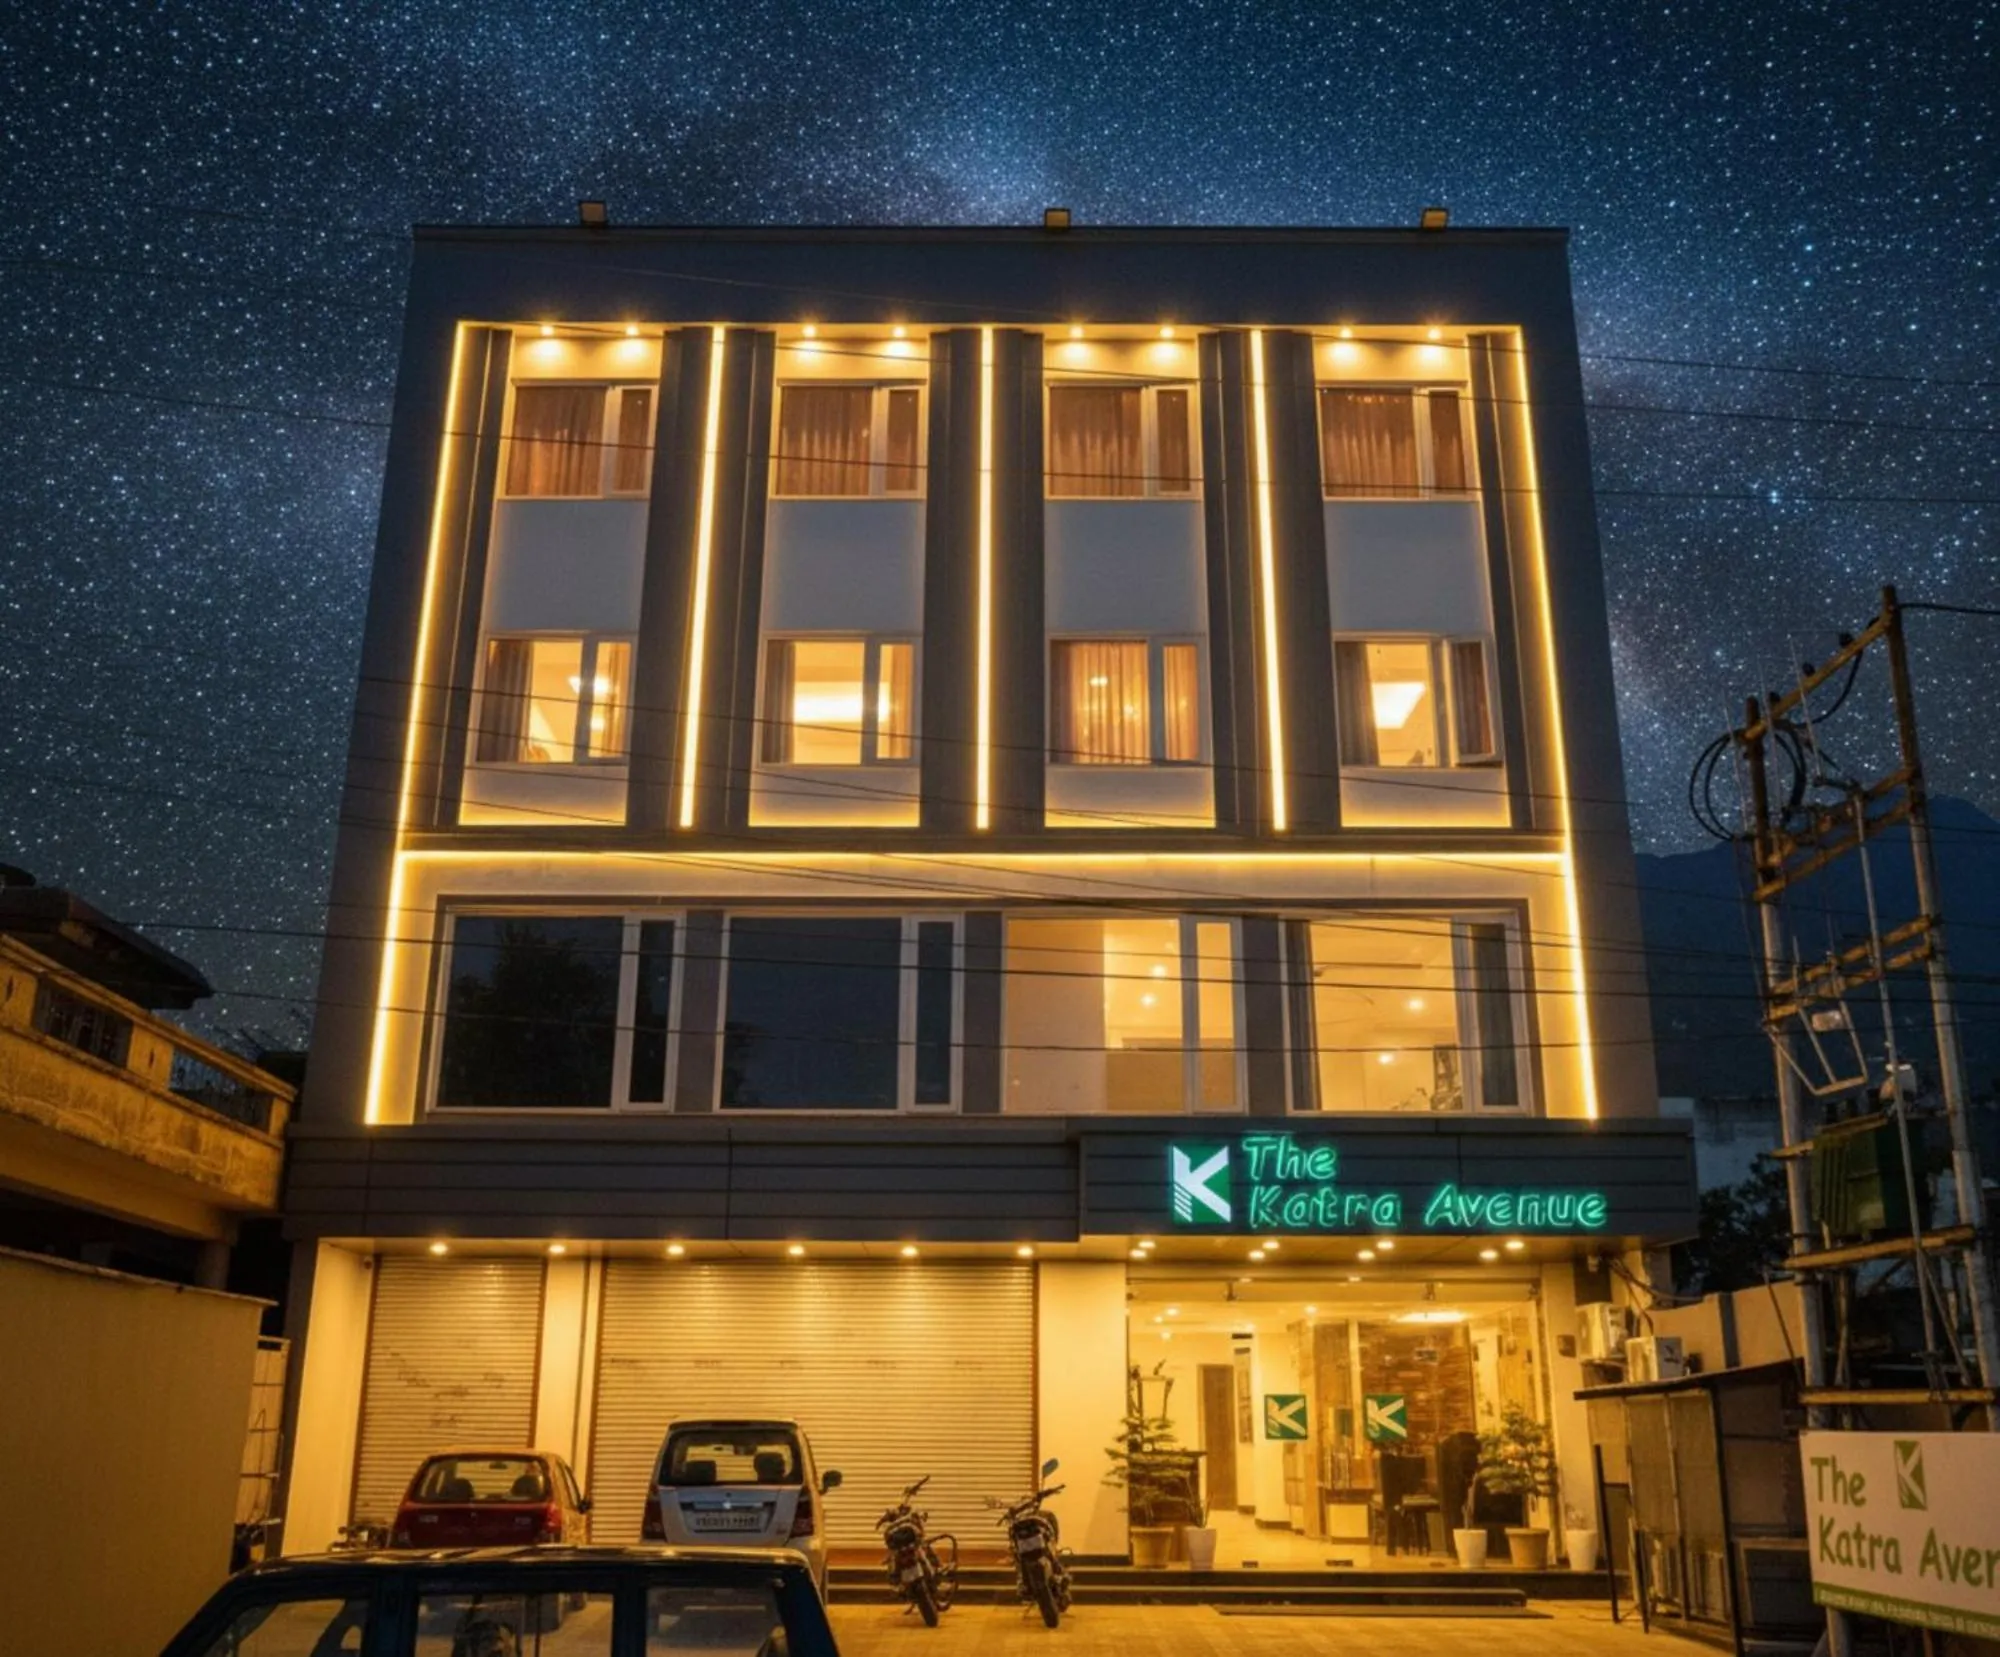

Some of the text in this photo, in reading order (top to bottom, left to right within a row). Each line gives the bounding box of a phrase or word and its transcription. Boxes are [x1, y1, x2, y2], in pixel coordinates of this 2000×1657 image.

[1242, 1135, 1336, 1181] The
[1250, 1184, 1607, 1228] Katra Avenue
[1810, 1455, 1866, 1506] The
[1818, 1515, 1902, 1574] Katra
